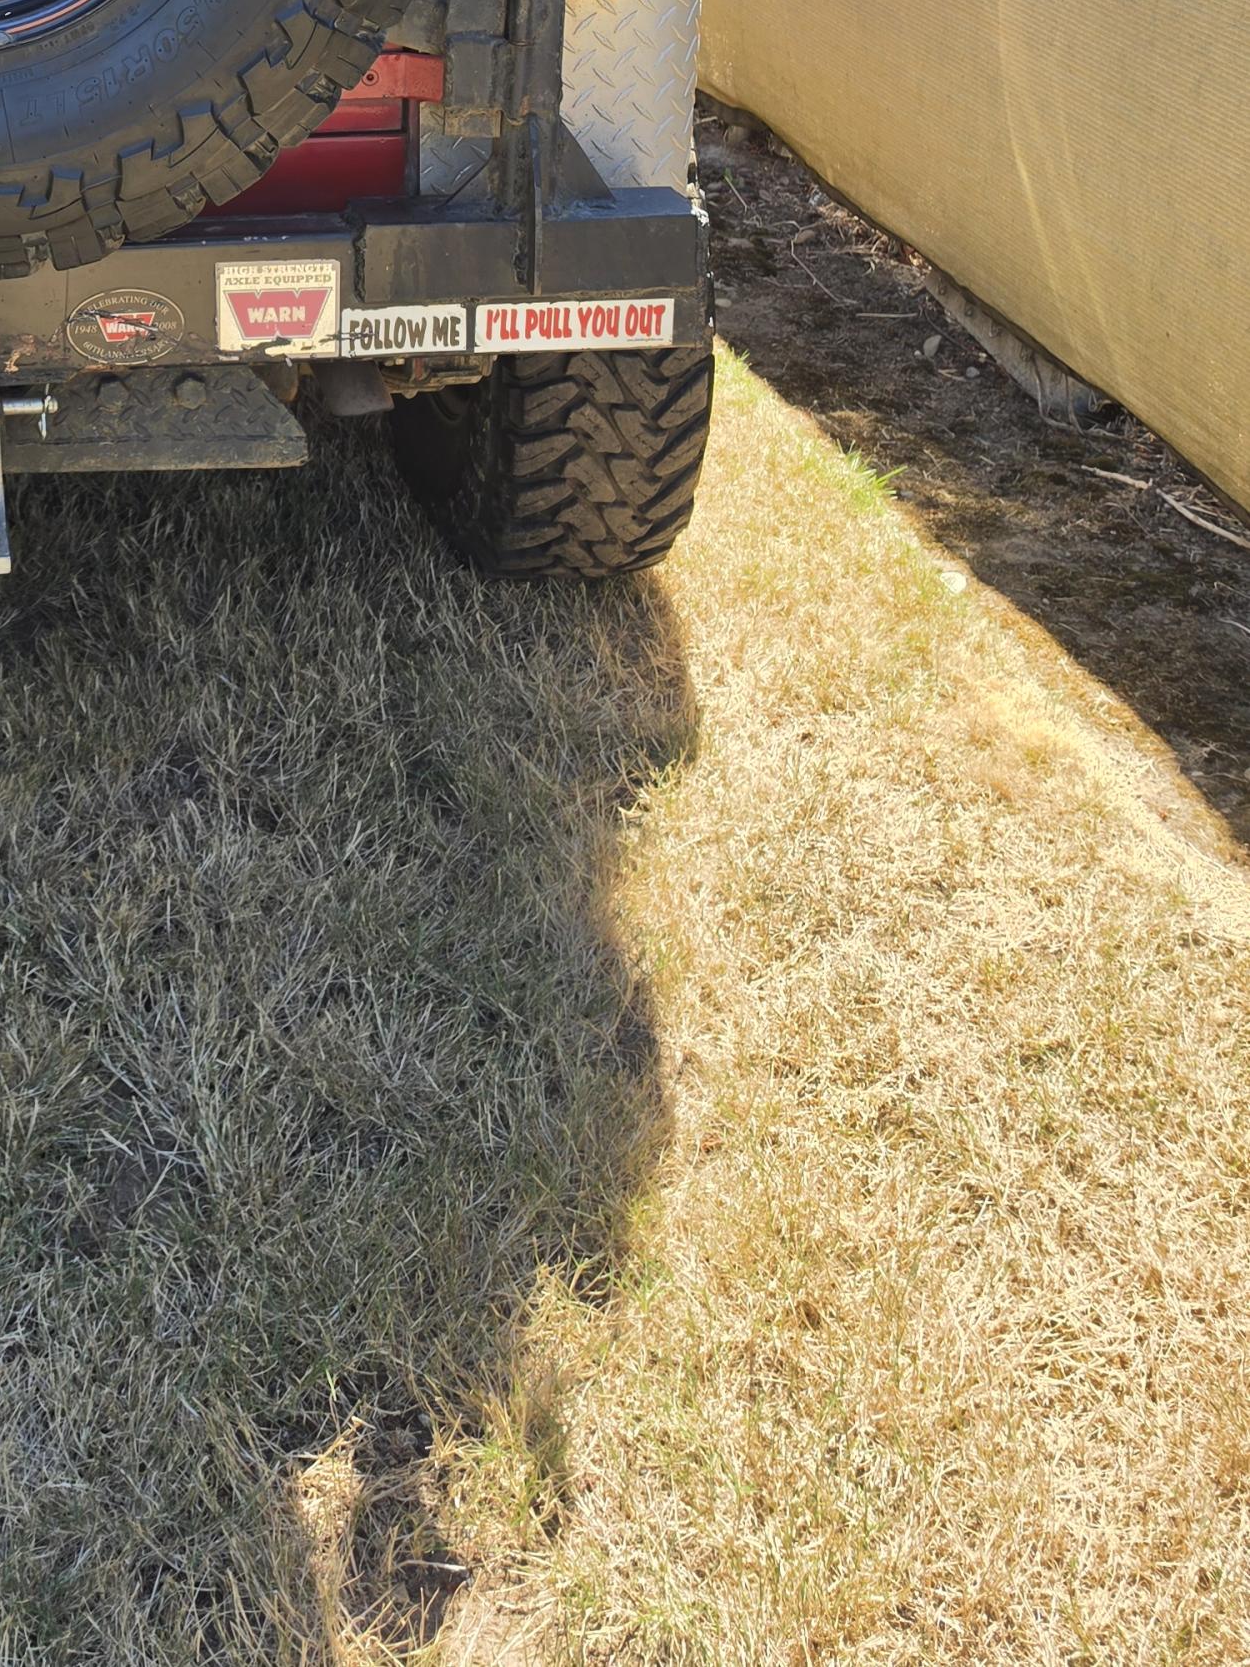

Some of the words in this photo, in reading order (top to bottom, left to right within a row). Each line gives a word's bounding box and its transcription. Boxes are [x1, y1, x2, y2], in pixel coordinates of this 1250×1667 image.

[223, 265, 259, 275] HIGH
[262, 263, 333, 274] STRENGTH
[224, 276, 261, 286] AXLE
[264, 274, 332, 286] EQUIPPED
[247, 306, 306, 323] WARN
[486, 308, 520, 341] I'LL
[525, 308, 572, 339] PULL
[577, 305, 620, 337] YOU
[625, 303, 666, 337] OUT
[74, 324, 98, 335] 1948
[350, 317, 428, 351] FOLLOW
[433, 316, 461, 347] ME
